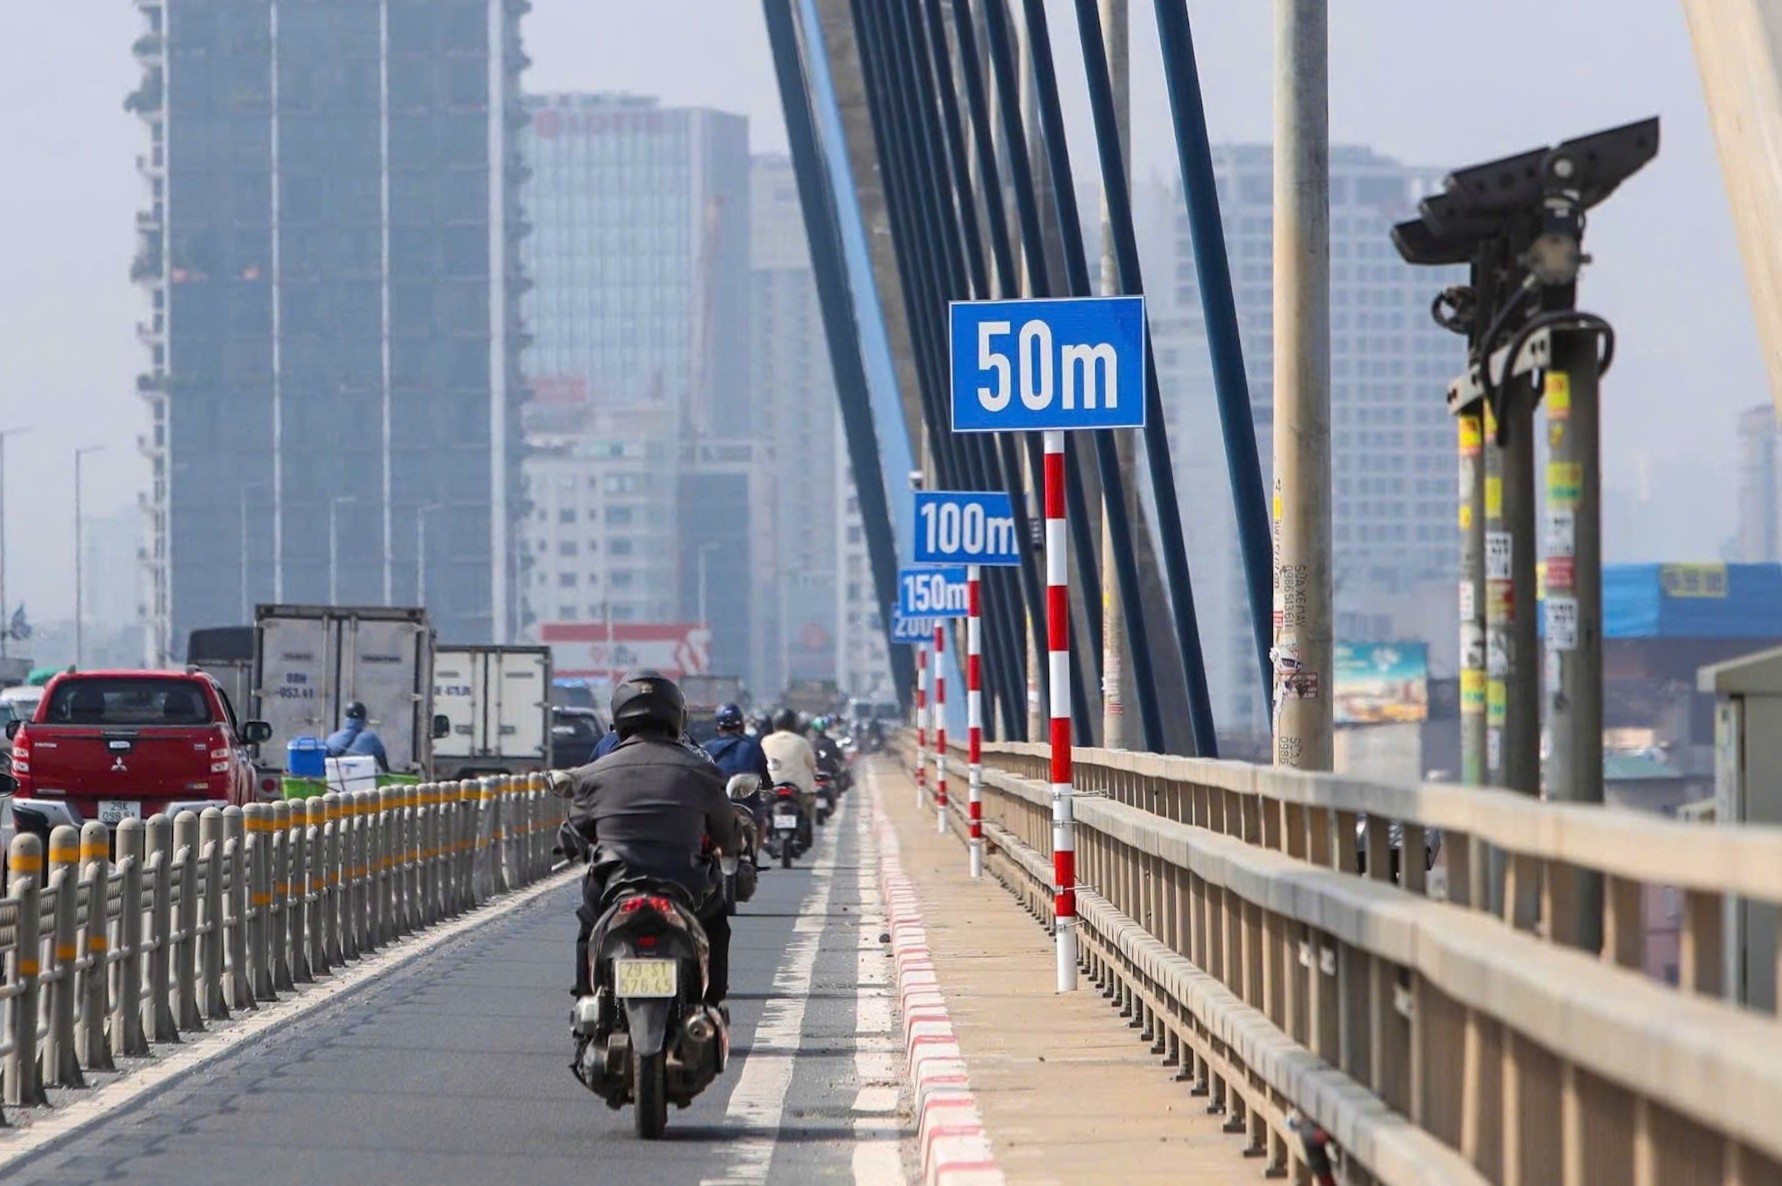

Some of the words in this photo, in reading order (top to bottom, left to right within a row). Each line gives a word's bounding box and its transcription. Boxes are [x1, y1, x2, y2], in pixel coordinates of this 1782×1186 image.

[977, 319, 1118, 412] 50m
[921, 502, 1019, 554] 100m
[903, 574, 969, 612] 150m
[894, 610, 934, 638] 200
